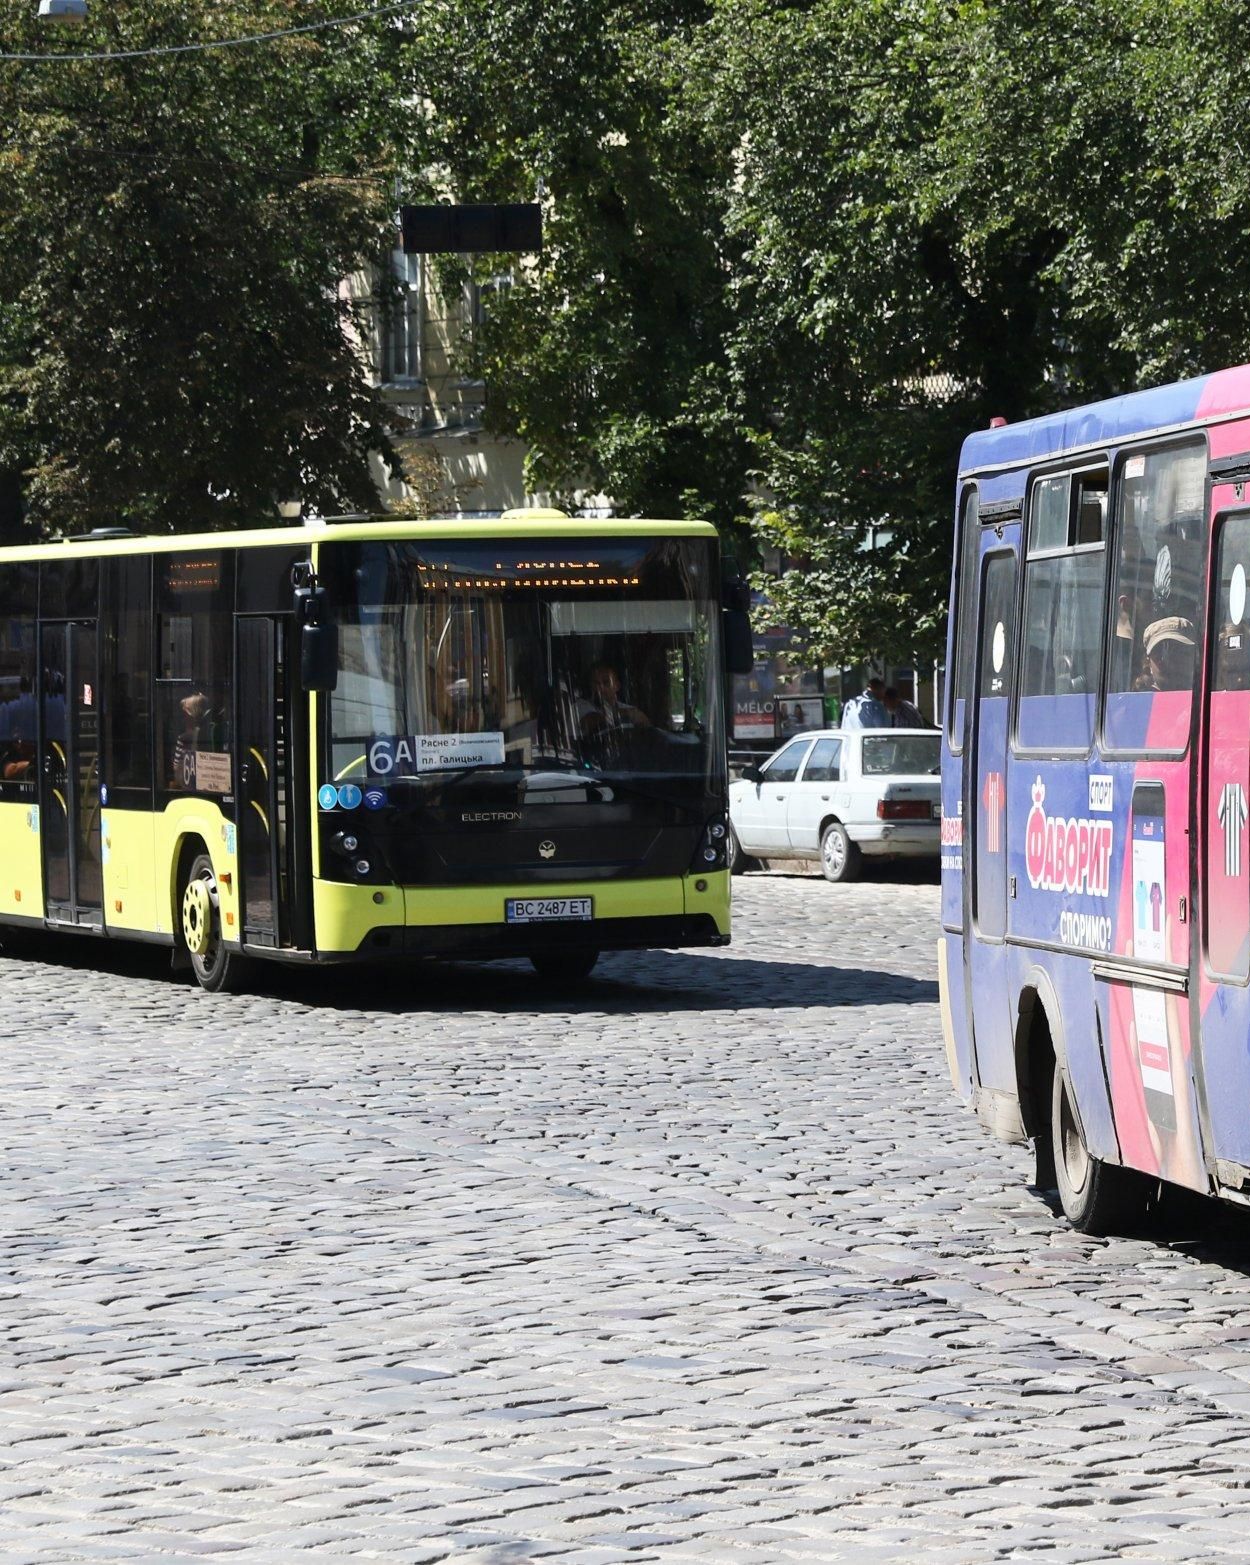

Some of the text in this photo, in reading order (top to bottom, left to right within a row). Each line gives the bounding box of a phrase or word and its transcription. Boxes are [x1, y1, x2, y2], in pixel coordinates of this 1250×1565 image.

[737, 702, 774, 714] MELO
[421, 738, 449, 748] Рясне
[451, 738, 457, 746] 2
[422, 754, 483, 765] пл. Галицька
[1090, 781, 1112, 805] СПОРТ
[461, 812, 522, 821] ELECTRON
[1026, 805, 1113, 897] ФАВОРИТ
[515, 900, 588, 916] BC 2487 ET
[1060, 911, 1112, 950] СПОРИМО?
